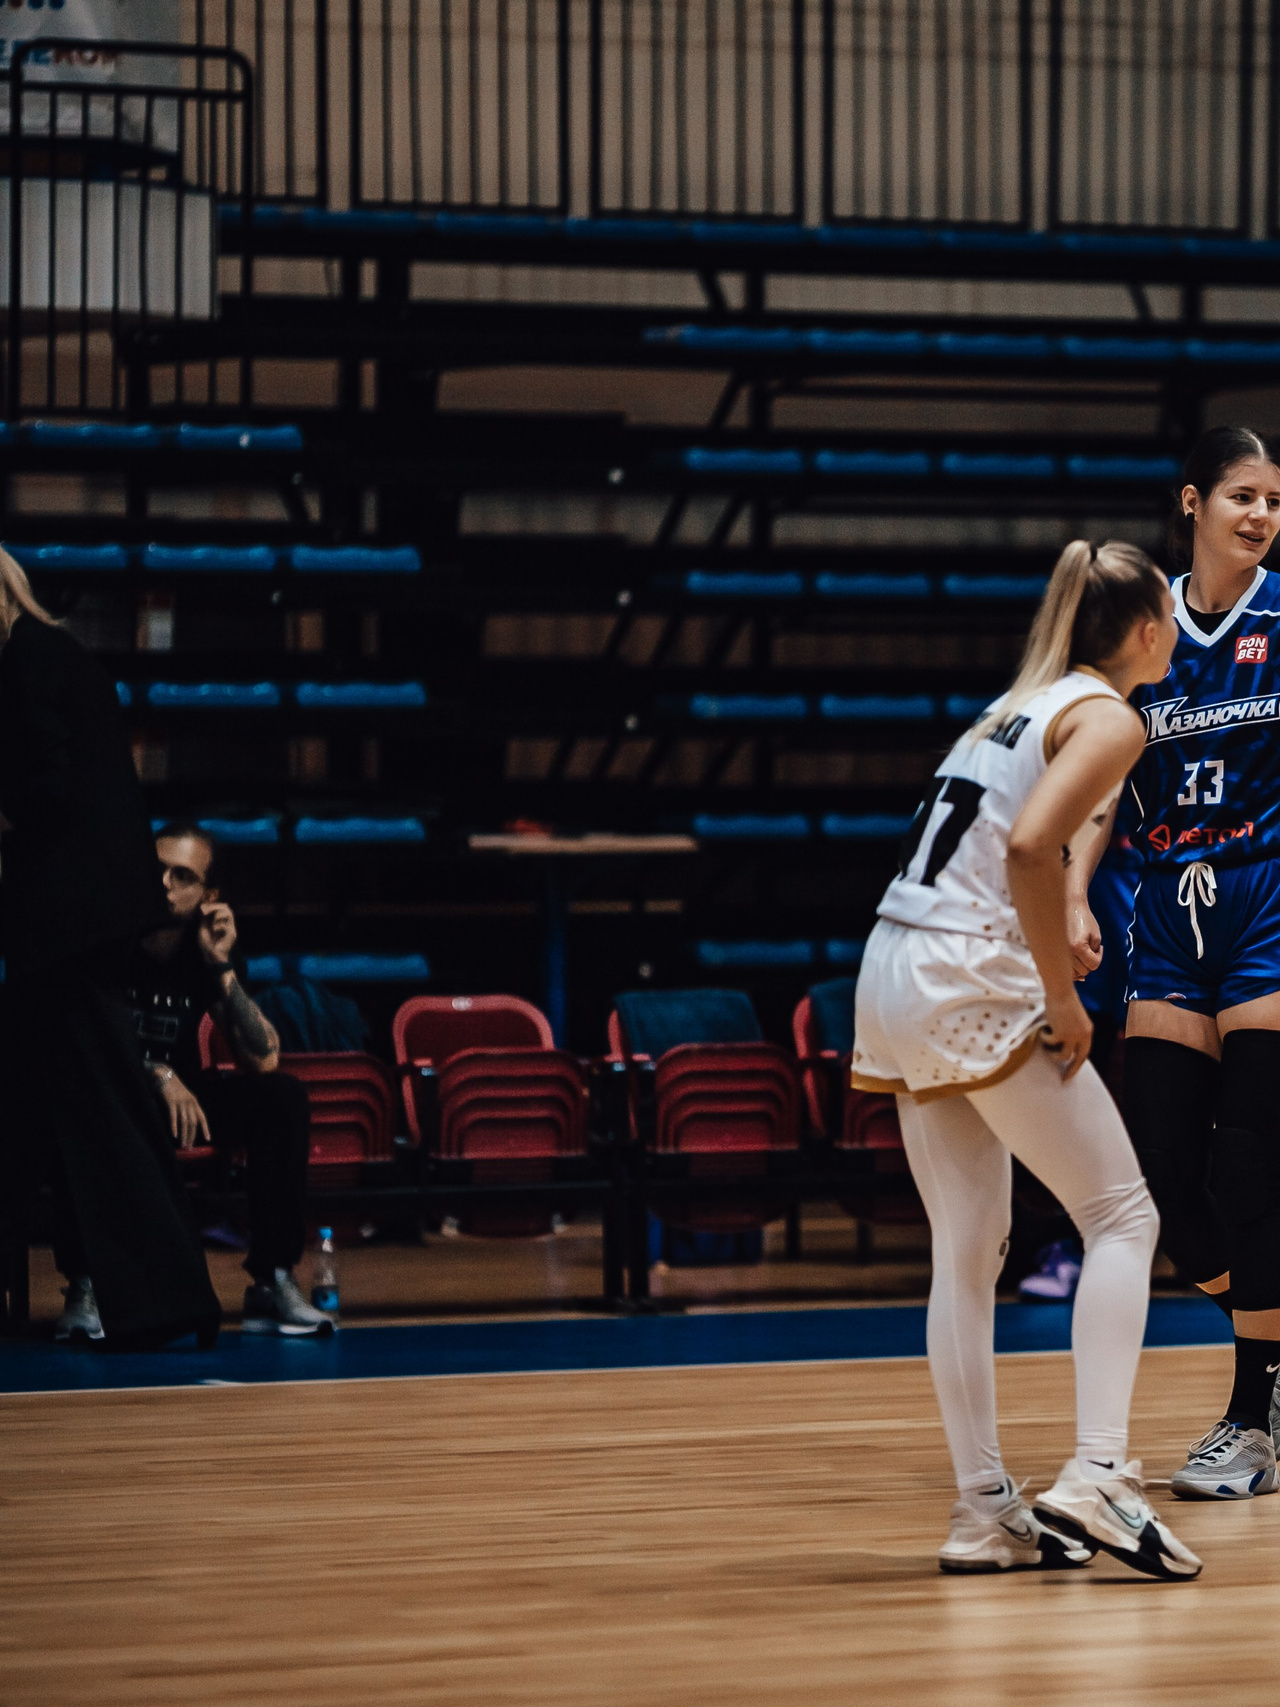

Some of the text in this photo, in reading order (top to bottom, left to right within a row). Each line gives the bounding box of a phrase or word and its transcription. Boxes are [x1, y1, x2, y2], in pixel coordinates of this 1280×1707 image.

[1238, 637, 1266, 650] FON
[1237, 648, 1266, 661] BET
[1177, 759, 1225, 806] 33
